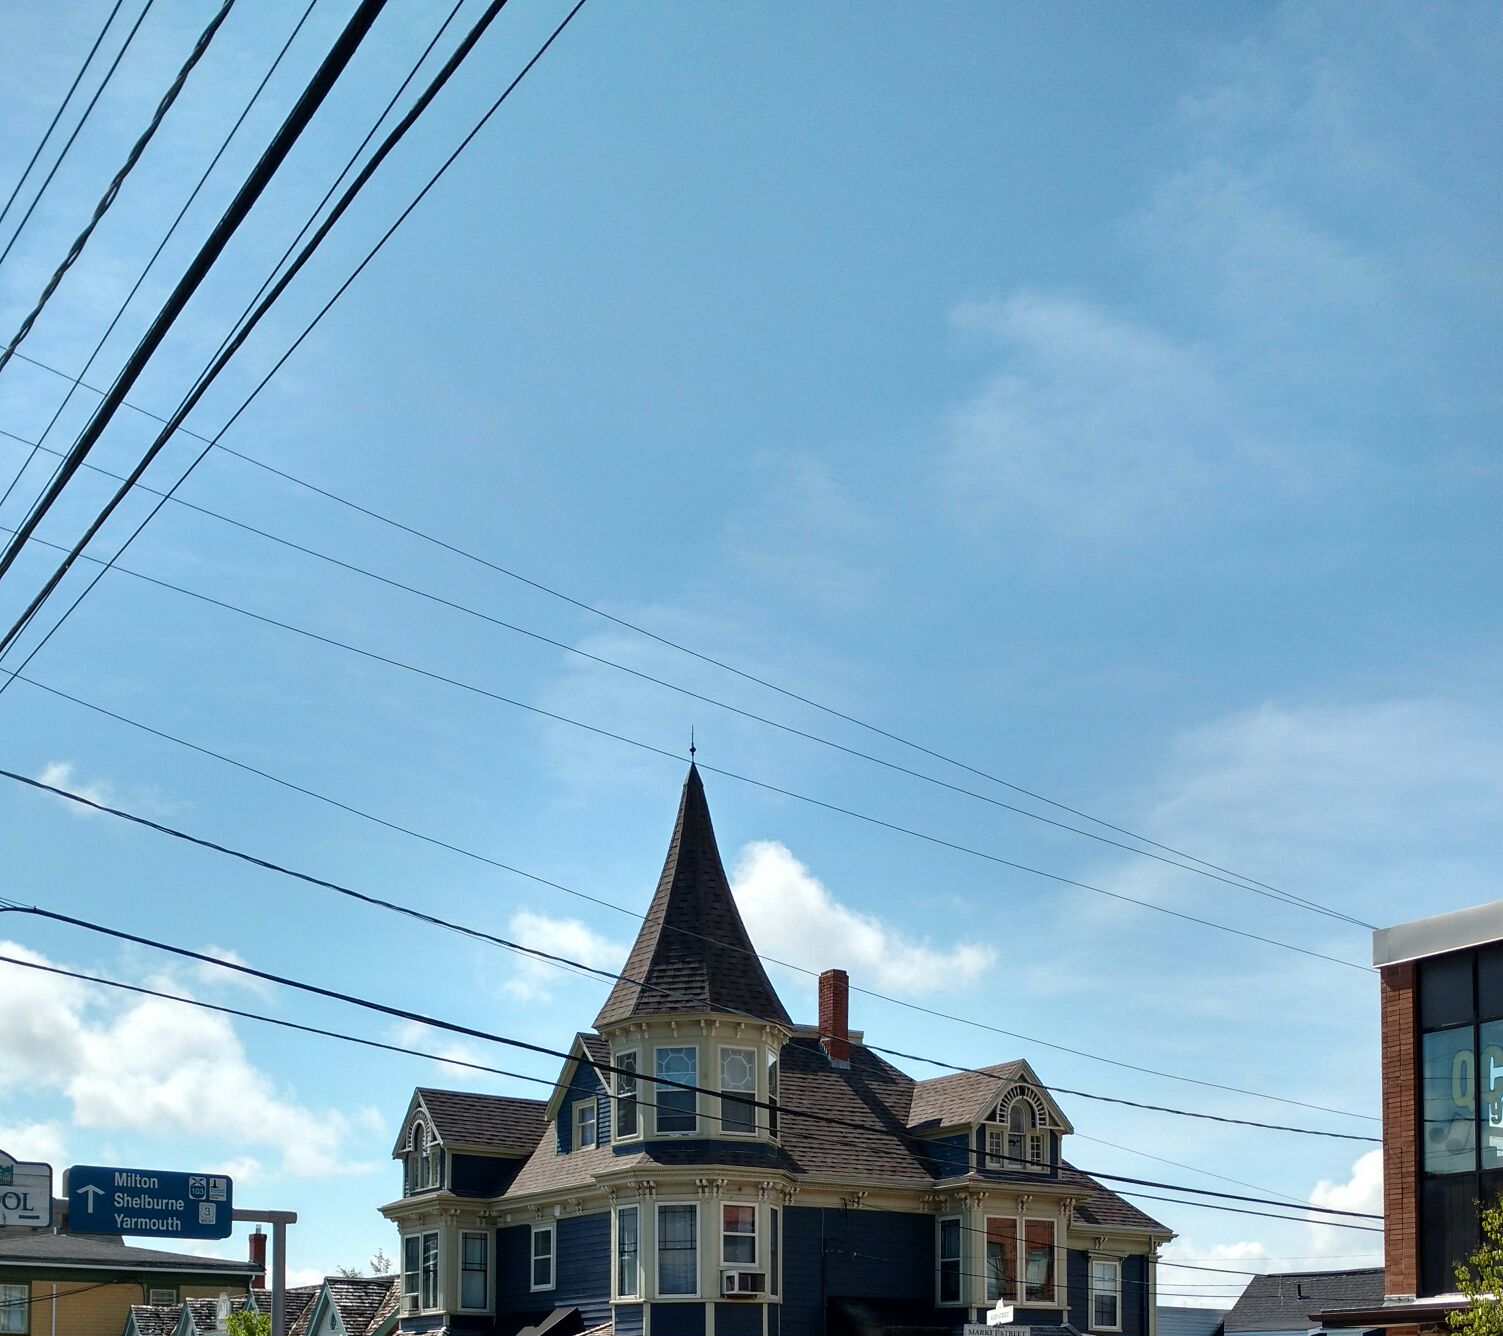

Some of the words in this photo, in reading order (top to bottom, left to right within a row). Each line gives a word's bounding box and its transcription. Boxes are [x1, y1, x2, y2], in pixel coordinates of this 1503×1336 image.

[114, 1172, 158, 1189] Milton
[192, 1187, 204, 1195] 103
[0, 1192, 34, 1211] OL
[114, 1192, 185, 1211] Shelburne
[204, 1206, 211, 1216] 3
[114, 1213, 181, 1231] Yarmouth
[968, 1328, 998, 1336] MARKET
[1000, 1329, 1026, 1336] STREET
